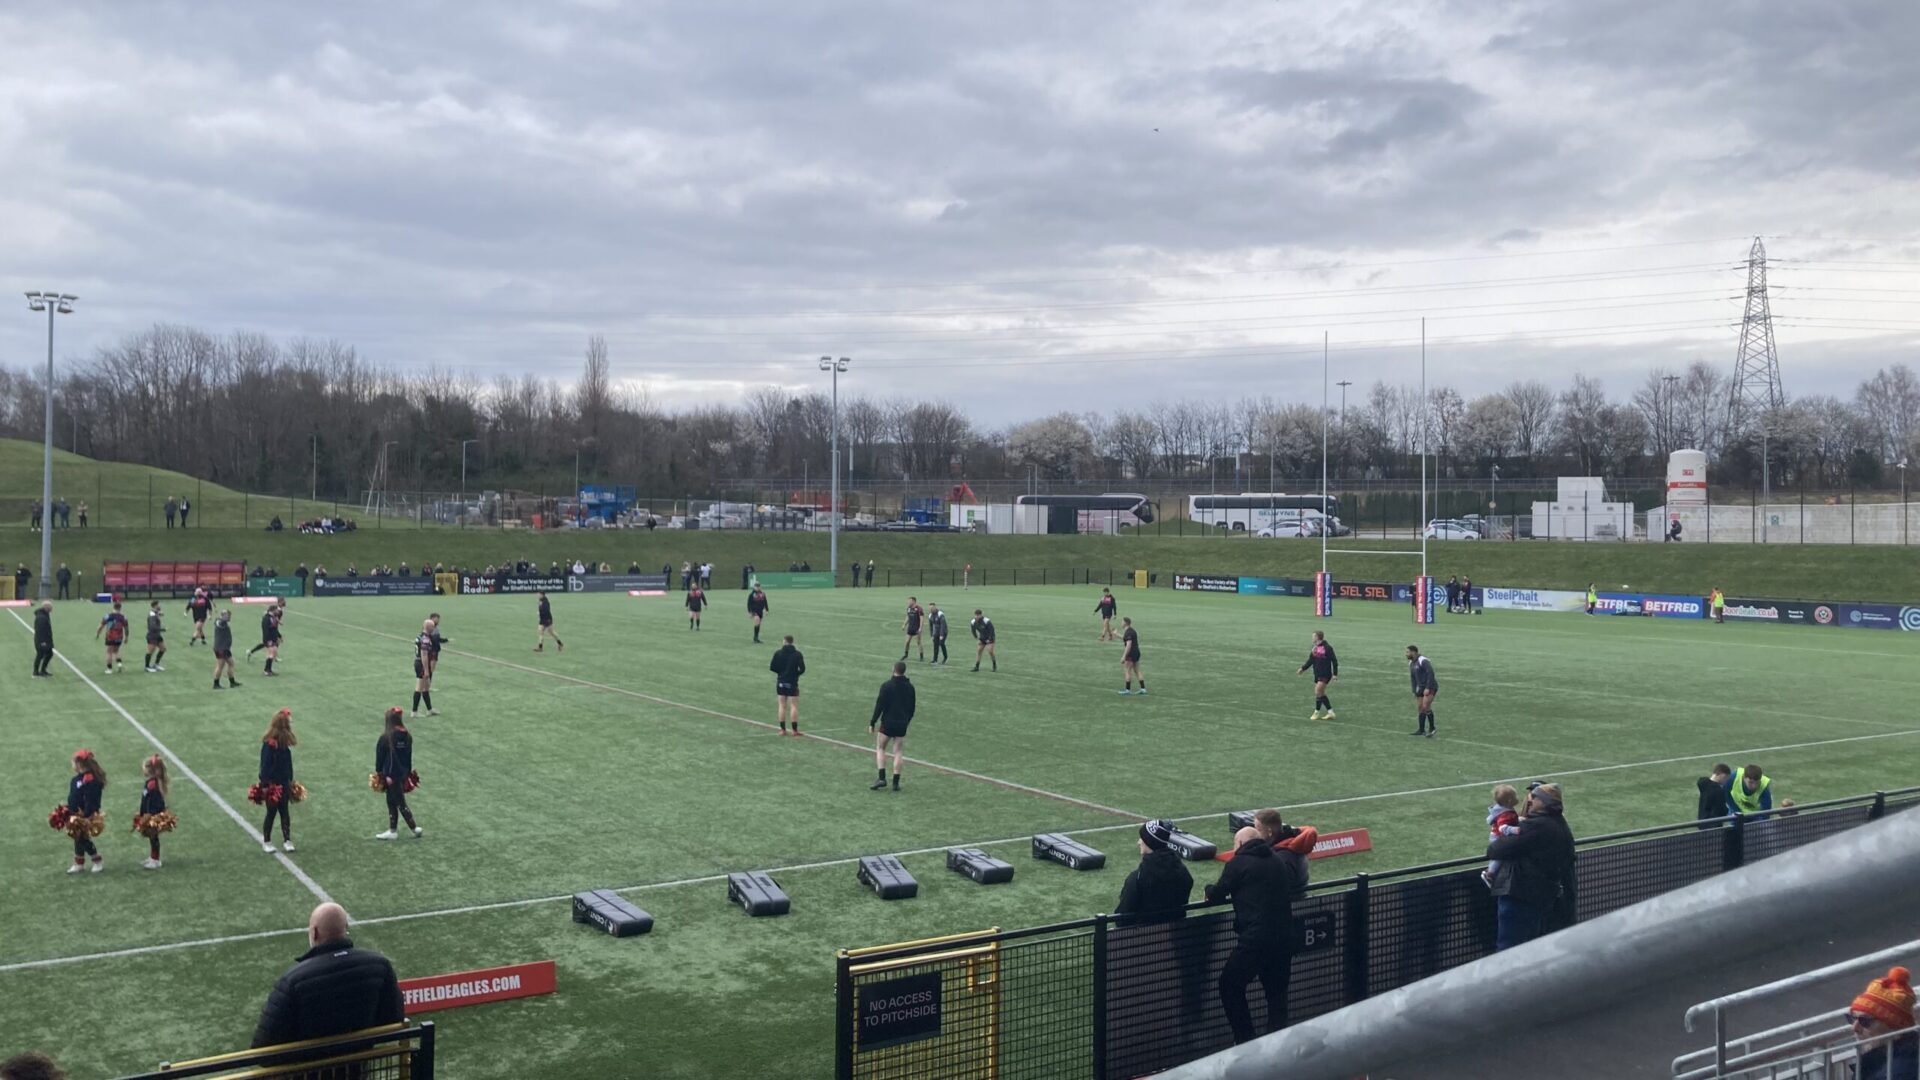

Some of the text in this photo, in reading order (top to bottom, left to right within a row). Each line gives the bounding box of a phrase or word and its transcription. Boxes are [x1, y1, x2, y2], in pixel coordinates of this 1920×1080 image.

[1340, 585, 1362, 597] STEL
[1365, 586, 1388, 598] STEL
[1487, 589, 1538, 602] SteelPhalt
[1645, 601, 1699, 613] BETFRED
[1305, 929, 1315, 946] B
[402, 975, 520, 1005] EFFIELDEAGLES.COM
[869, 991, 932, 1012] NO ACCESS
[864, 1003, 937, 1027] TO PITCHSIDE
